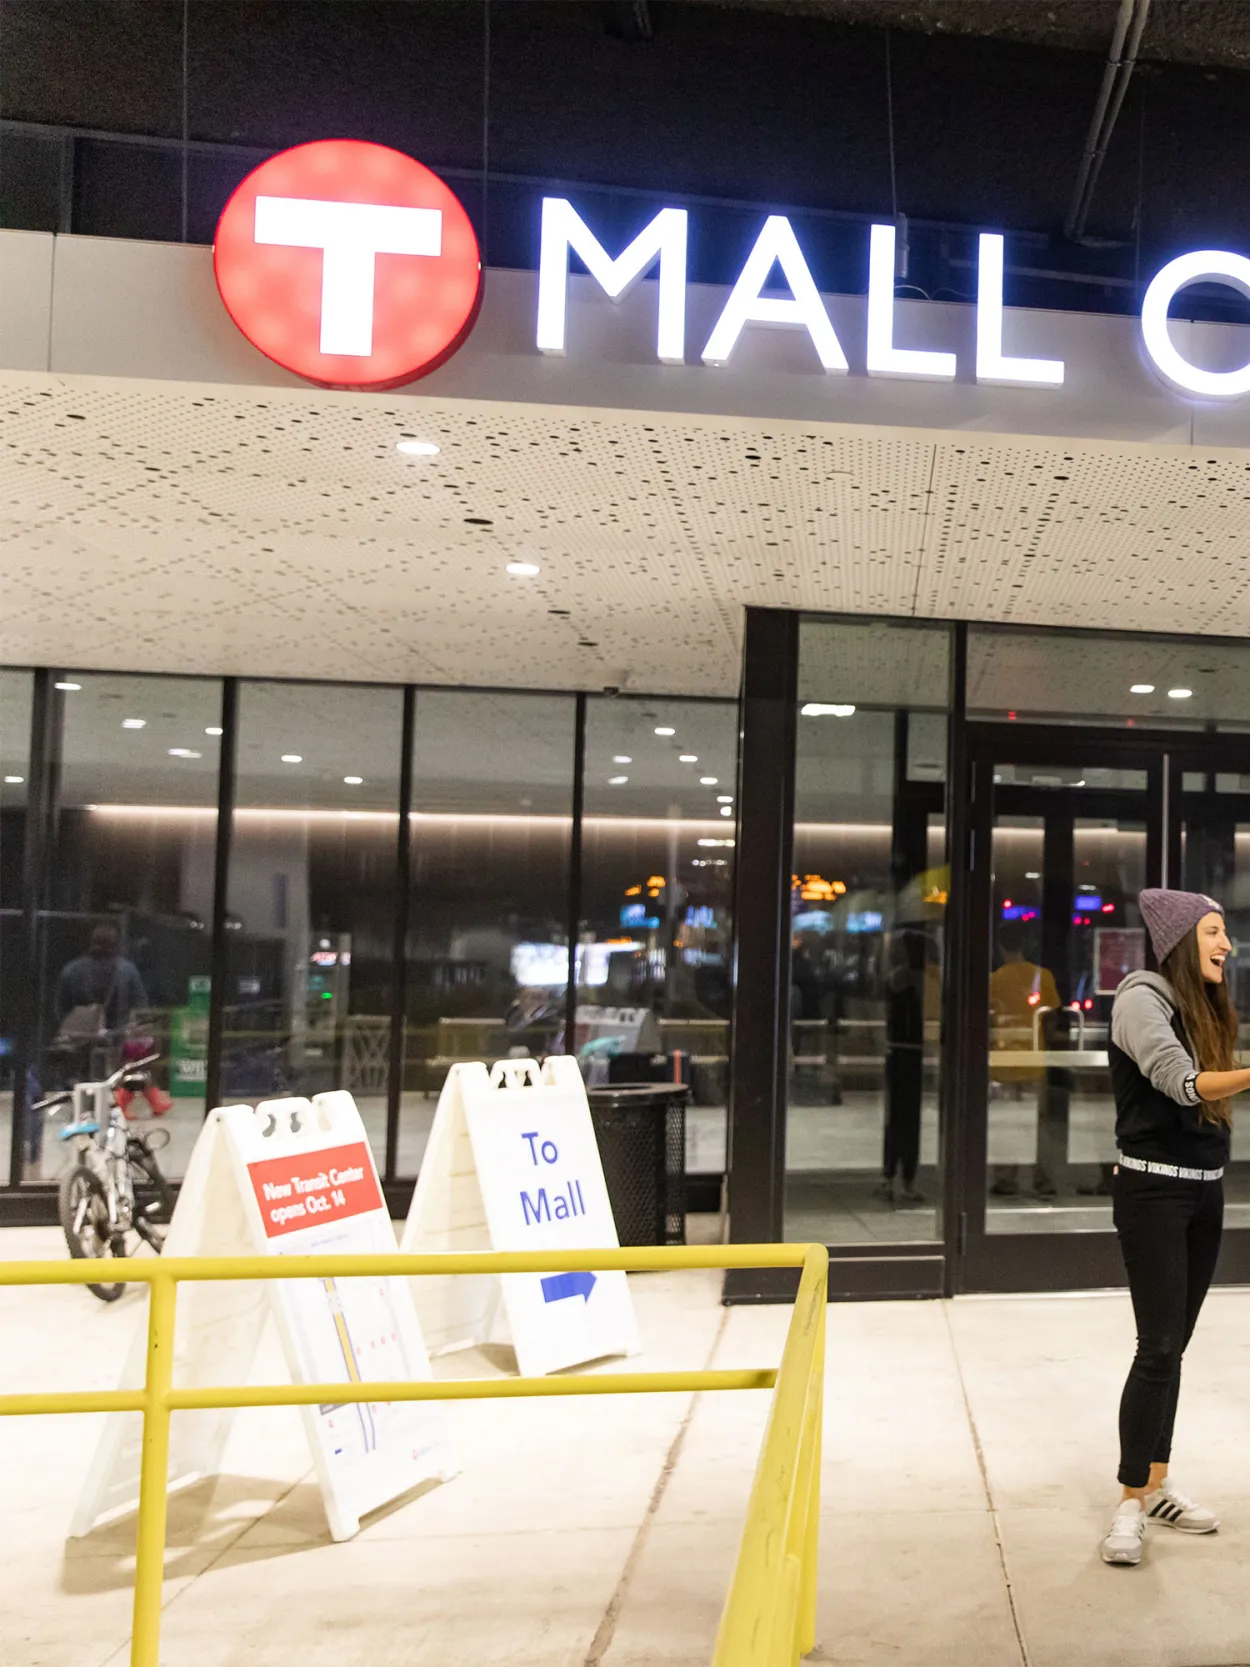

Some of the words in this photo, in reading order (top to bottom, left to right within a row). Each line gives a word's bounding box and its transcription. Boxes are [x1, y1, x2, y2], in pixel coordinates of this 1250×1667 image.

[254, 195, 442, 357] T
[535, 196, 1065, 388] MALL
[521, 1131, 558, 1166] To
[262, 1181, 292, 1201] New
[290, 1171, 330, 1195] Transit
[329, 1166, 364, 1187] Center
[1147, 1161, 1179, 1178] VIKINGS
[269, 1202, 307, 1226] opens
[305, 1195, 331, 1215] Oct.
[330, 1189, 346, 1207] 14
[519, 1180, 586, 1226] Mall
